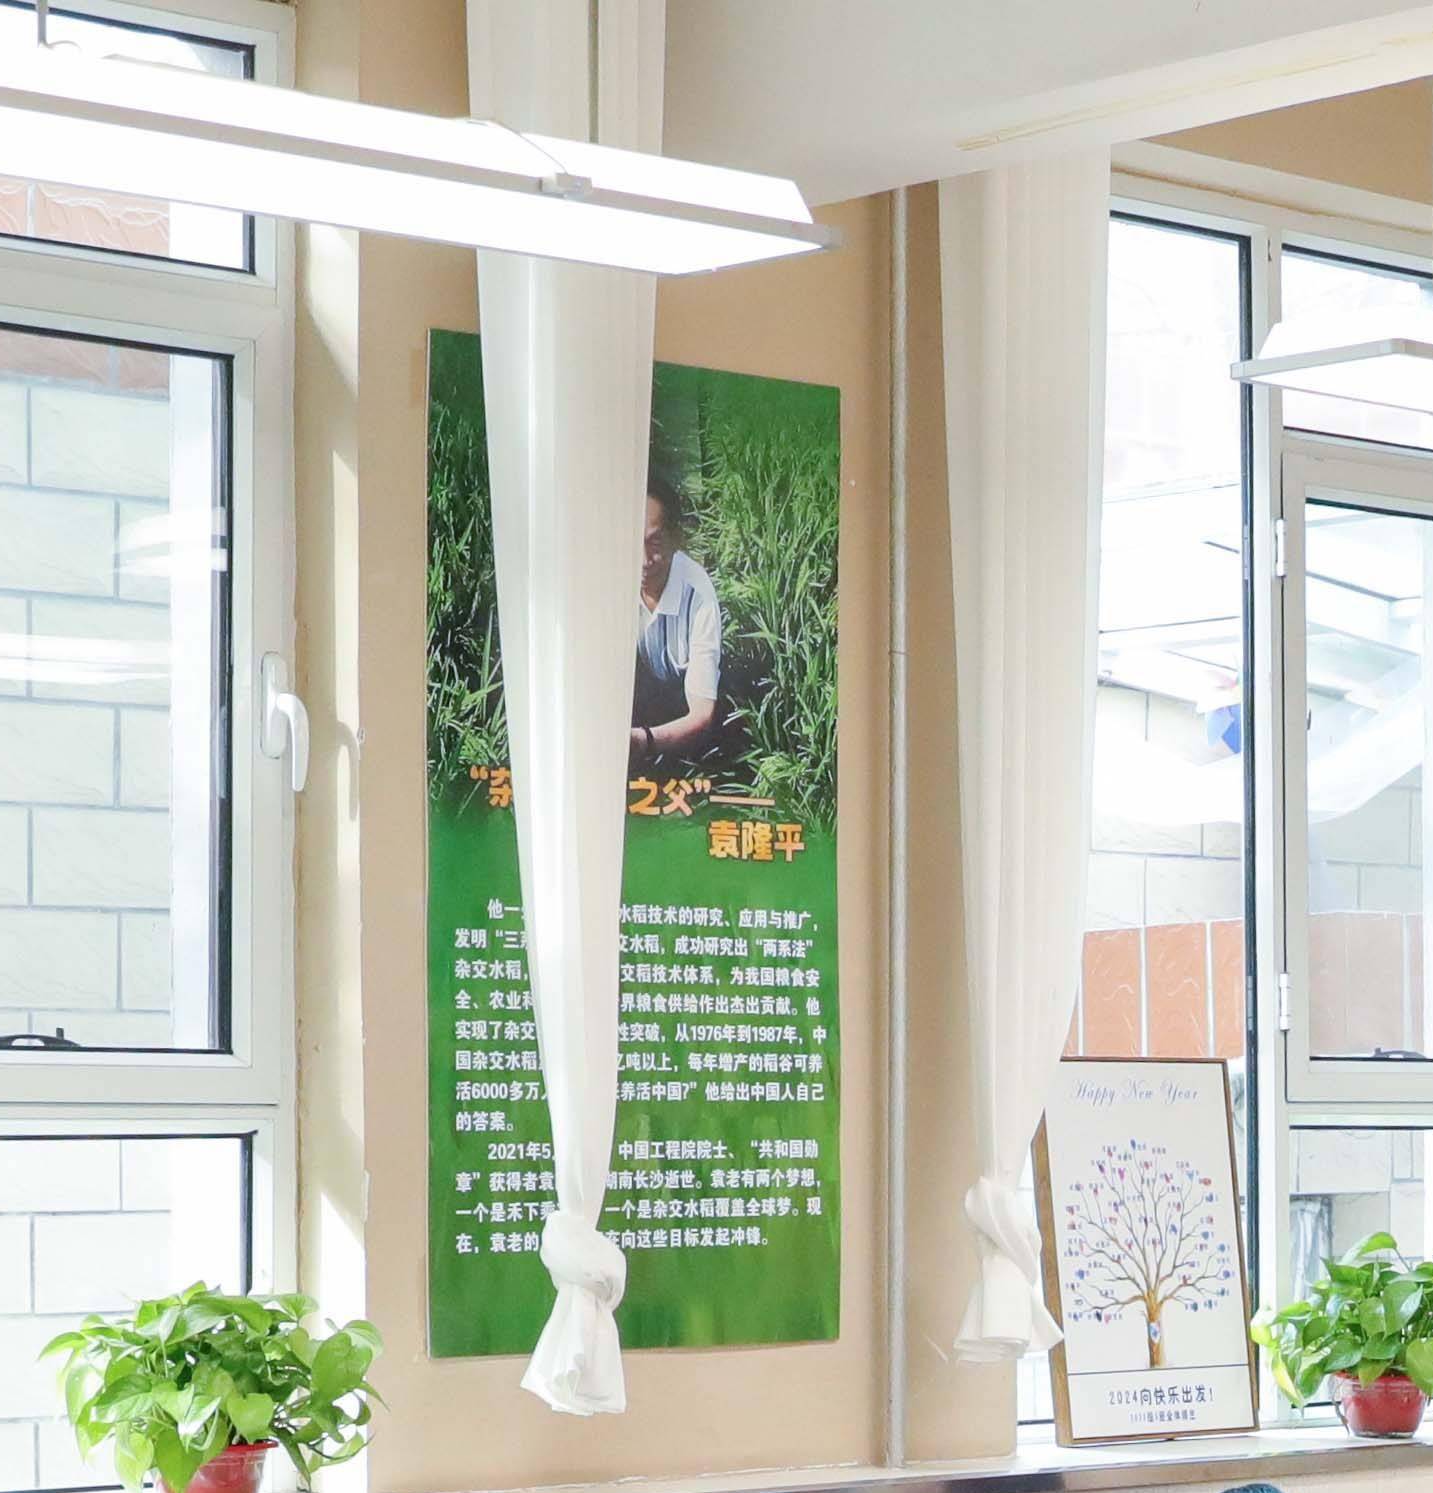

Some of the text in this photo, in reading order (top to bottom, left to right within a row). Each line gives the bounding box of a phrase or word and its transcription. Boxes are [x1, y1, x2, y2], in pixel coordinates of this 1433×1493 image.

[709, 820, 805, 863] 袁隆平
[487, 898, 526, 920] 他一
[618, 993, 821, 1016] 界粮食供给作出杰出贡献。他
[455, 1021, 536, 1042] 实现了杂交
[455, 1050, 543, 1072] 国杂交水稻
[1071, 1077, 1199, 1106] Happy New Year
[455, 1111, 514, 1133] 的答案。
[488, 1142, 556, 1161] 2021年5
